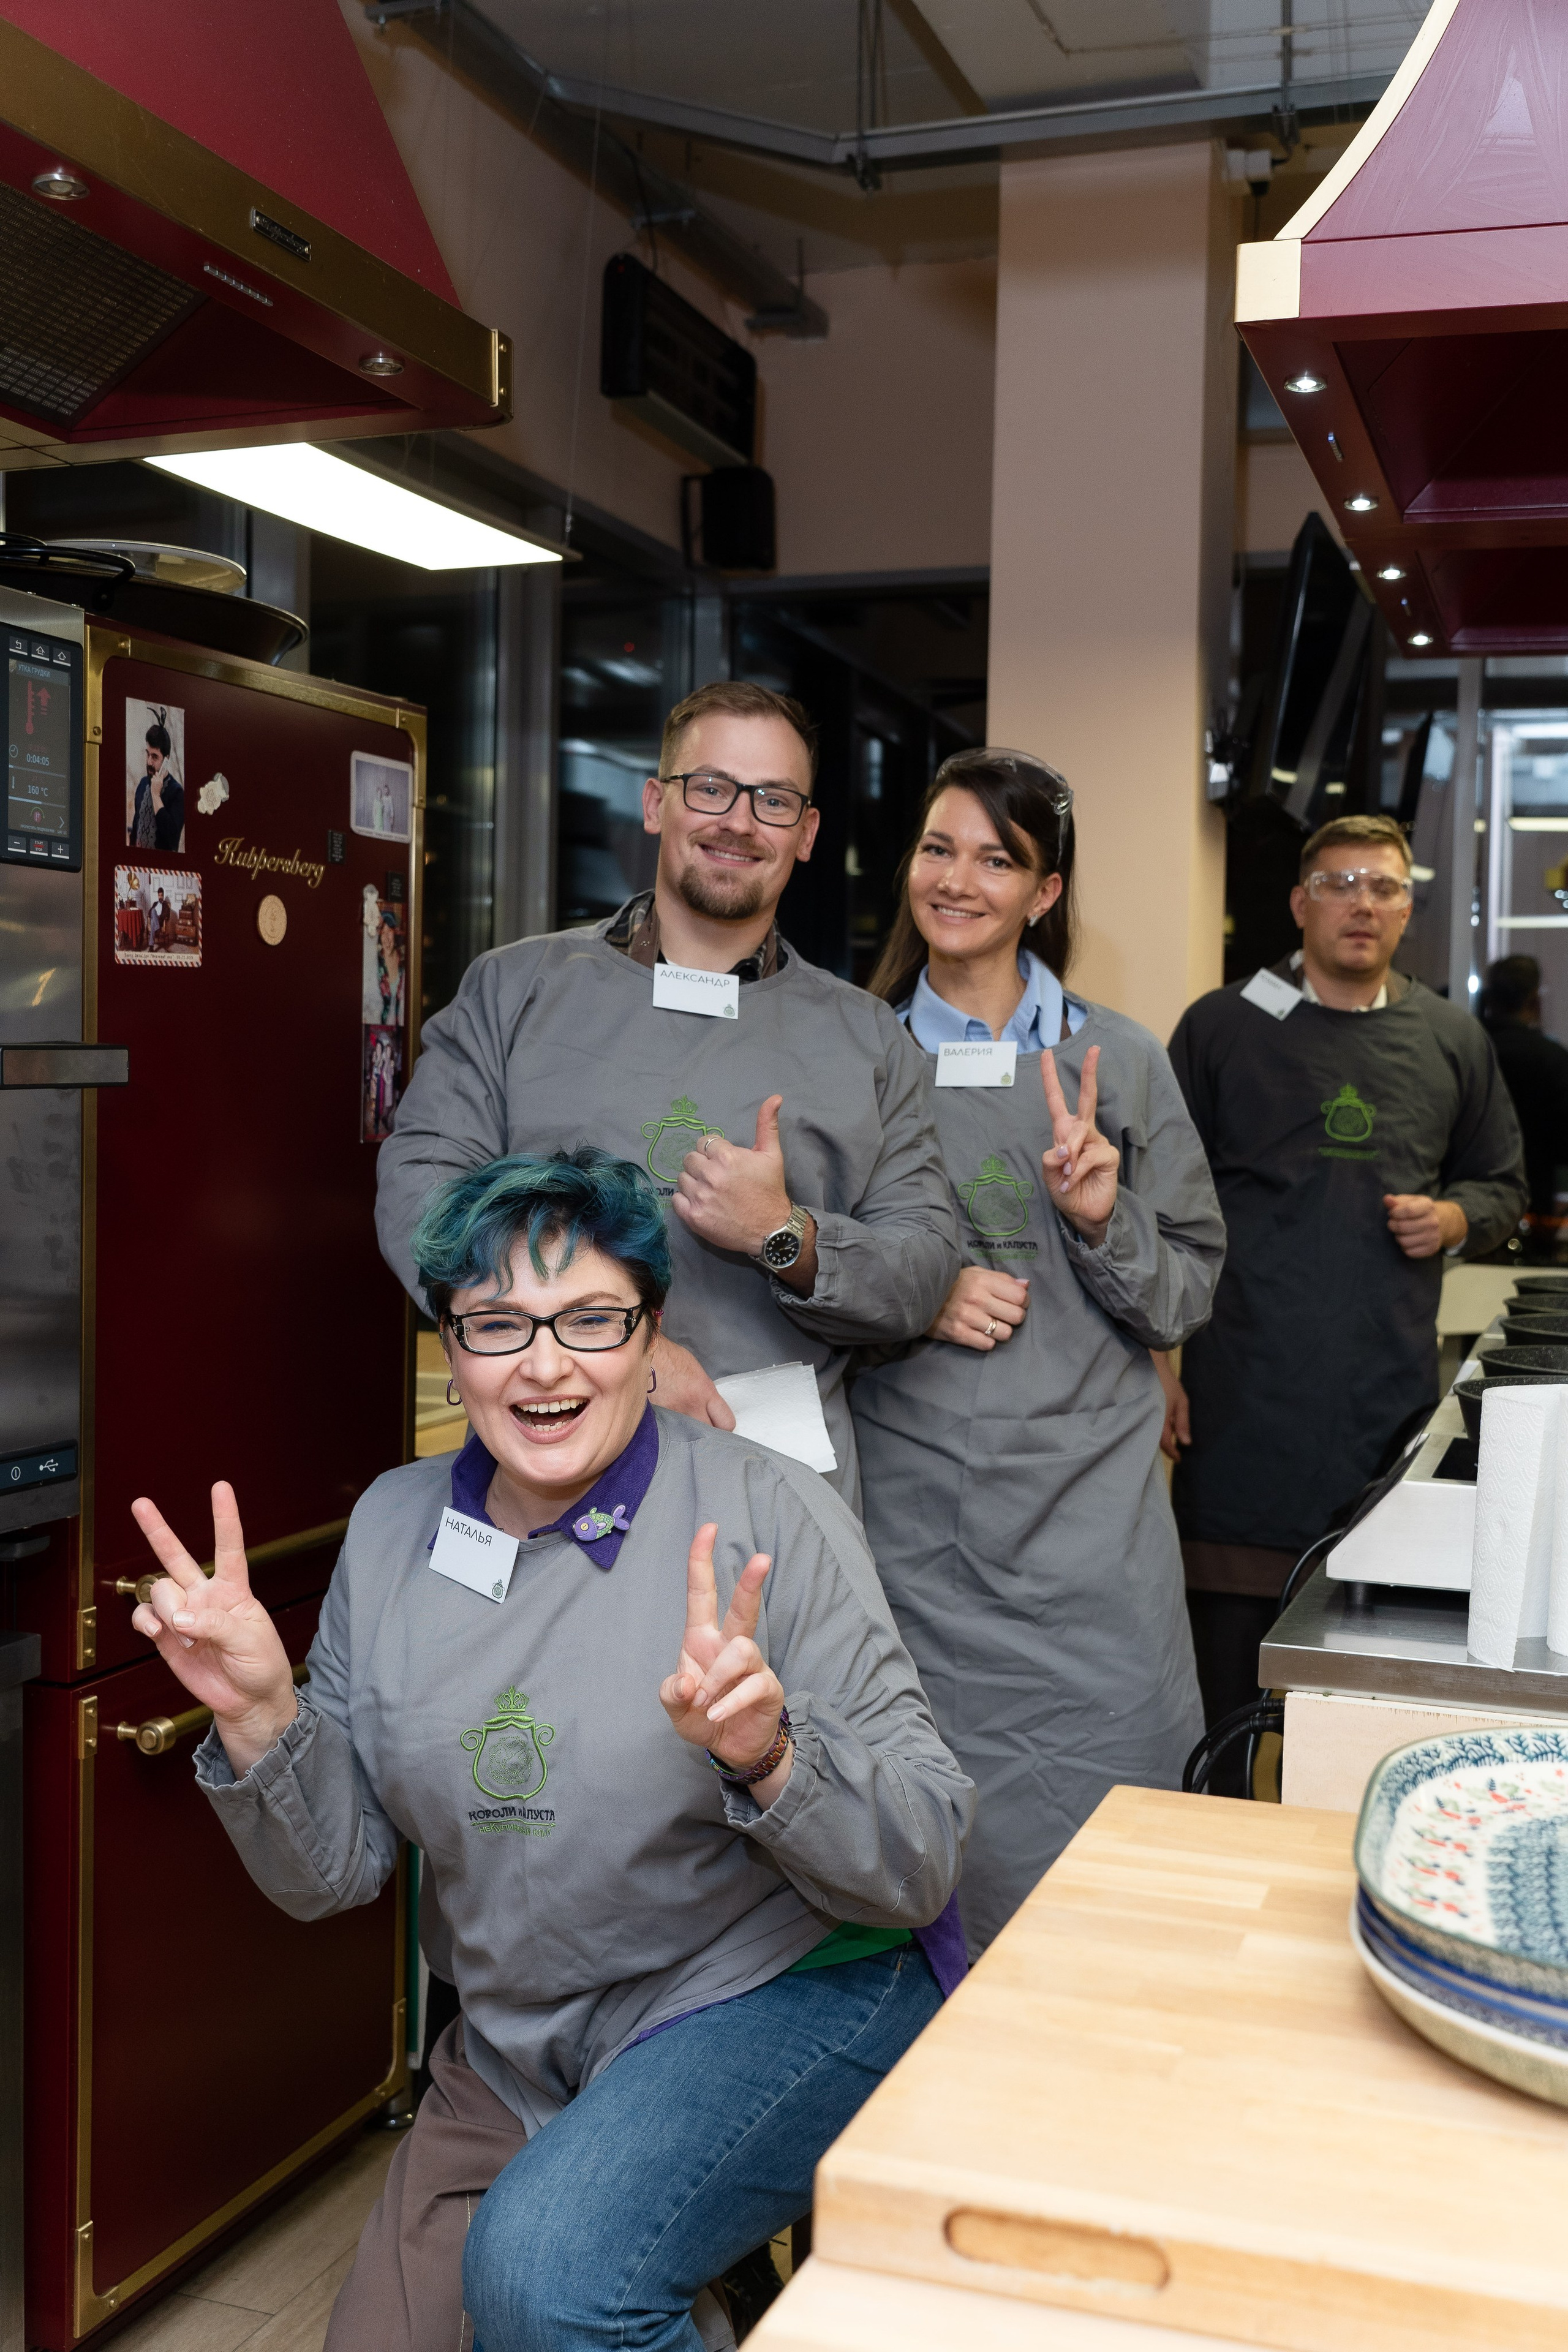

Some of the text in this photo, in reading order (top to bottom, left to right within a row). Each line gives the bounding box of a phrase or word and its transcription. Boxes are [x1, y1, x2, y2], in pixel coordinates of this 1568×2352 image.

[18, 664, 31, 673] УТКА
[26, 753, 50, 766] 0:04:05
[28, 785, 39, 795] 160
[660, 970, 730, 987] АЛЕКСАНДР
[944, 1047, 992, 1057] ВАЛЕРИЯ
[1003, 1241, 1038, 1250] КАПУСТА
[445, 1517, 492, 1547] НАТАЛЬЯ
[469, 1806, 516, 1820] КОРОЛИ
[533, 1828, 551, 1839] клуб
